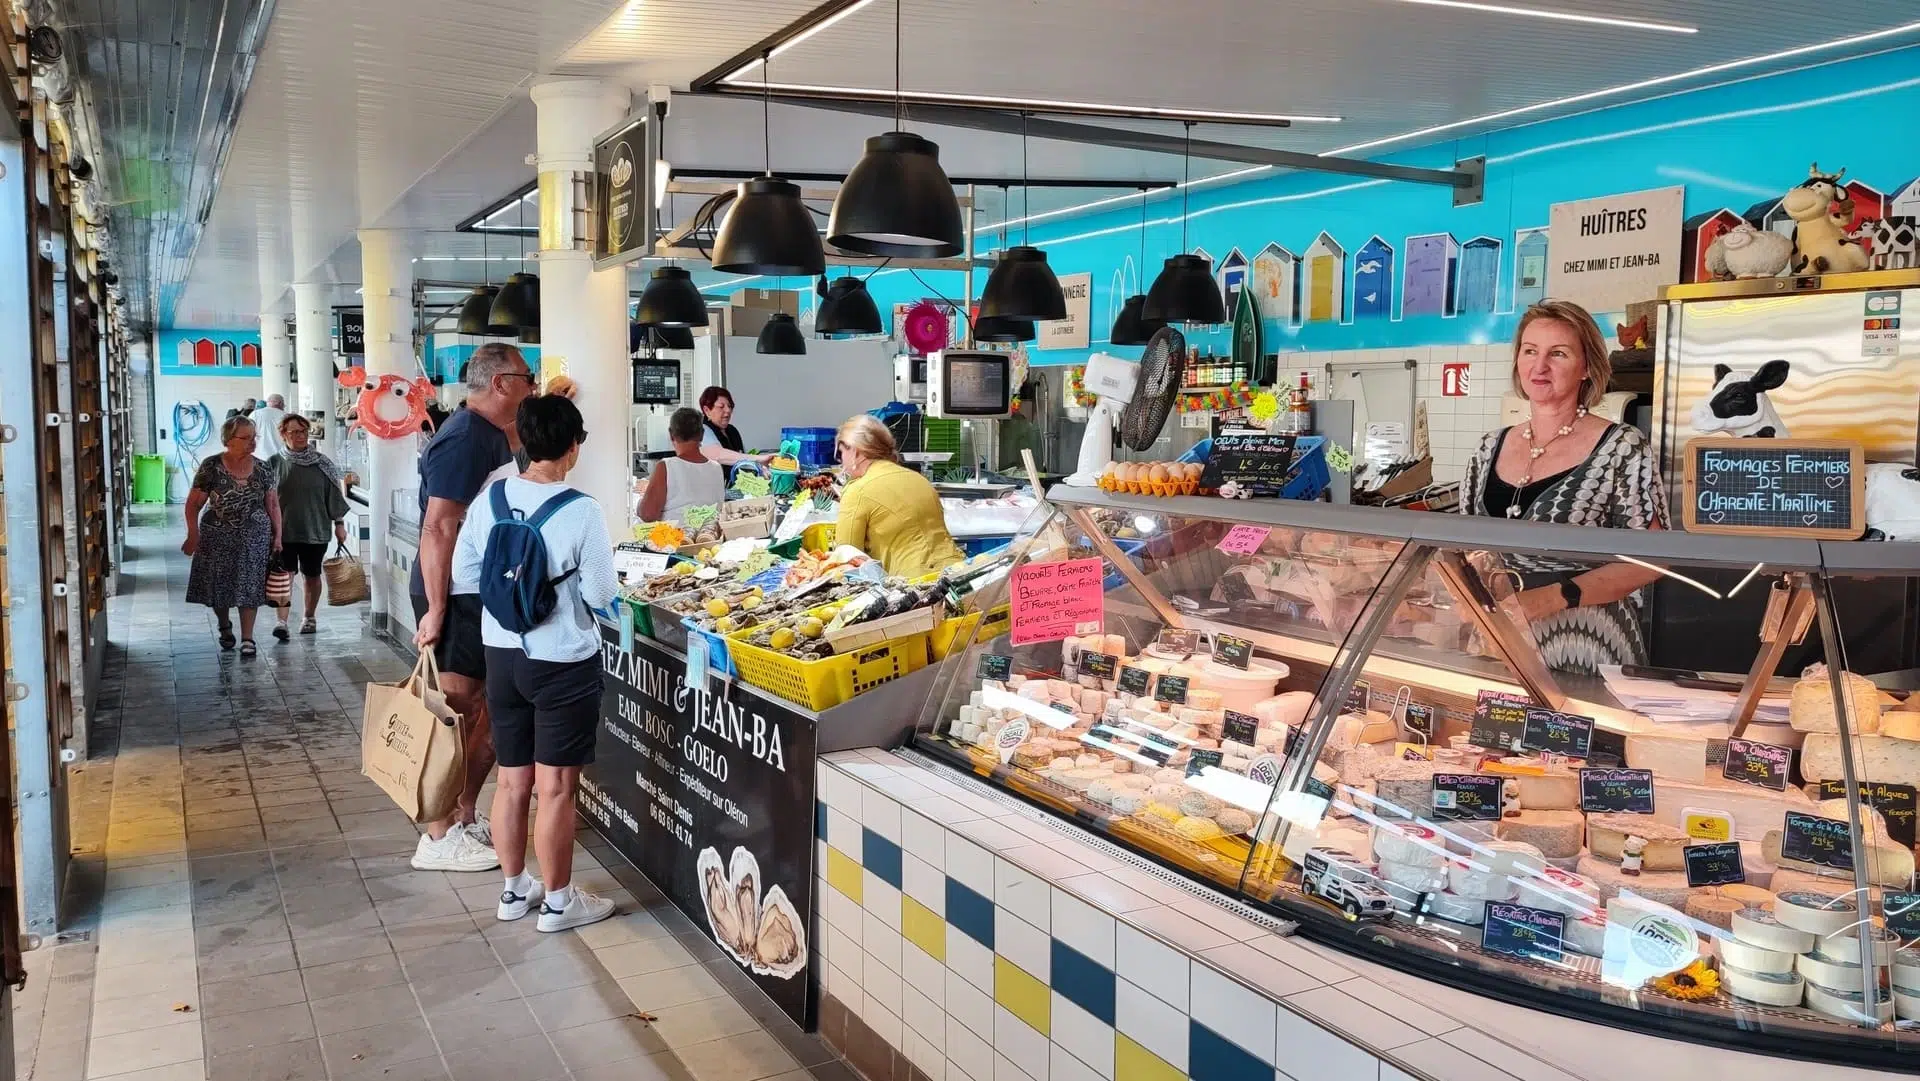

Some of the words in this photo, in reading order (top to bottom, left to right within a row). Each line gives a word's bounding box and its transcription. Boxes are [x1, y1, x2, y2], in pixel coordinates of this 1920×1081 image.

[1580, 207, 1647, 236] HUÎTRES
[1563, 259, 1585, 274] CHEZ
[1587, 258, 1608, 272] MIMI
[1610, 256, 1621, 270] ET
[1622, 253, 1660, 269] JEAN-BA
[1756, 476, 1783, 489] DE
[1020, 600, 1032, 612] ET
[627, 652, 670, 706] MIMI
[674, 674, 690, 713] &
[692, 687, 786, 772] JEAN-BA
[618, 693, 643, 730] EARL
[645, 710, 675, 750] BOSC
[683, 735, 728, 784] GOELO
[595, 785, 603, 802] La
[614, 800, 623, 820] les
[623, 808, 639, 834] Bains
[636, 770, 657, 798] Marché
[657, 787, 674, 813] Saint
[674, 799, 693, 827] Denis
[679, 767, 712, 802] Expéditeur
[712, 794, 724, 811] sur
[724, 798, 749, 828] Oléron
[658, 808, 666, 828] 63
[666, 813, 675, 834] 61
[675, 818, 684, 842] 41
[684, 829, 693, 849] 74
